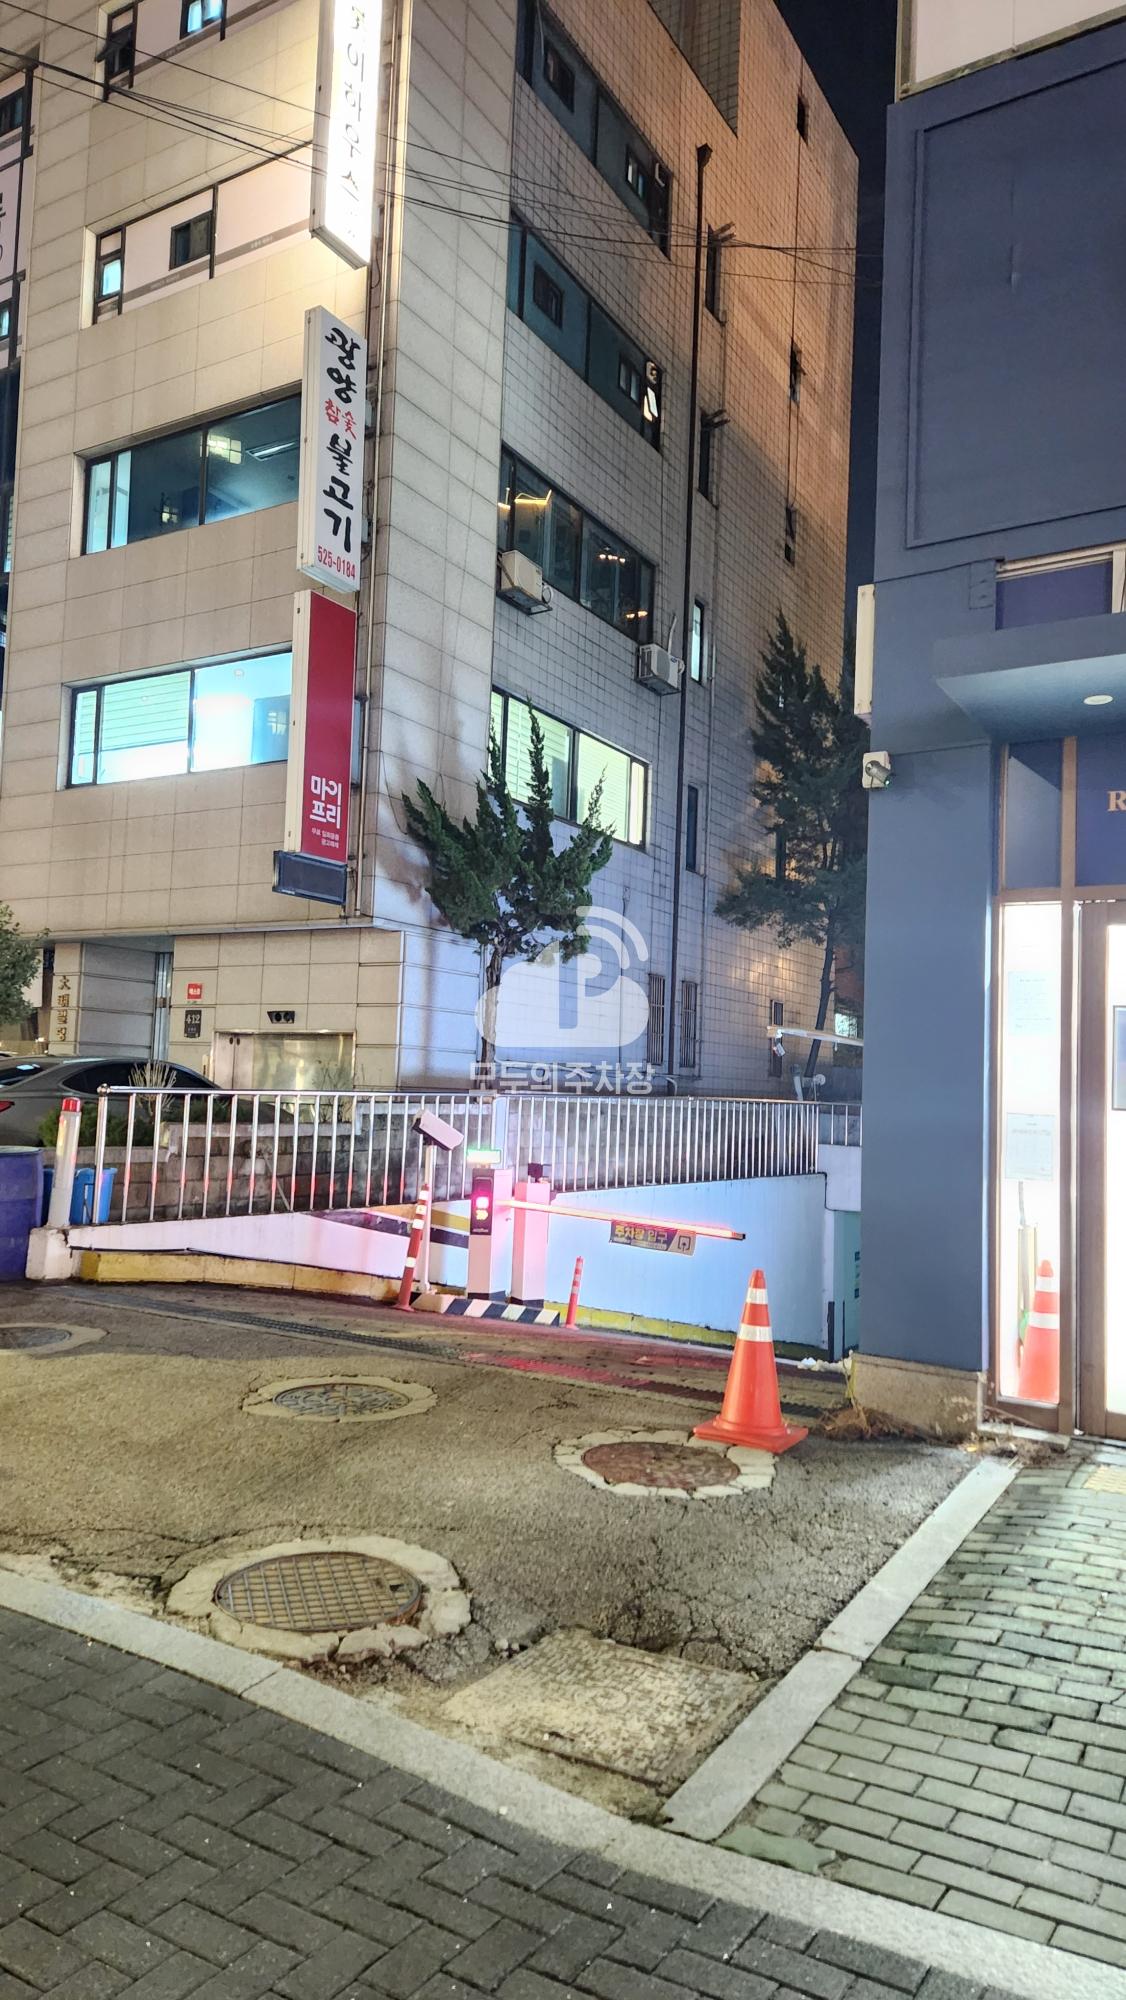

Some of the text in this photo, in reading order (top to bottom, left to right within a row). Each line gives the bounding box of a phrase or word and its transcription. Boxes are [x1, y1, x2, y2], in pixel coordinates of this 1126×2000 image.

[325, 327, 361, 404] 광양
[323, 433, 354, 553] 불고기
[317, 546, 356, 580] 525-0184
[311, 775, 342, 806] 마이
[309, 800, 341, 829] 프리
[186, 1013, 201, 1025] 412
[614, 1223, 645, 1241] 주차장
